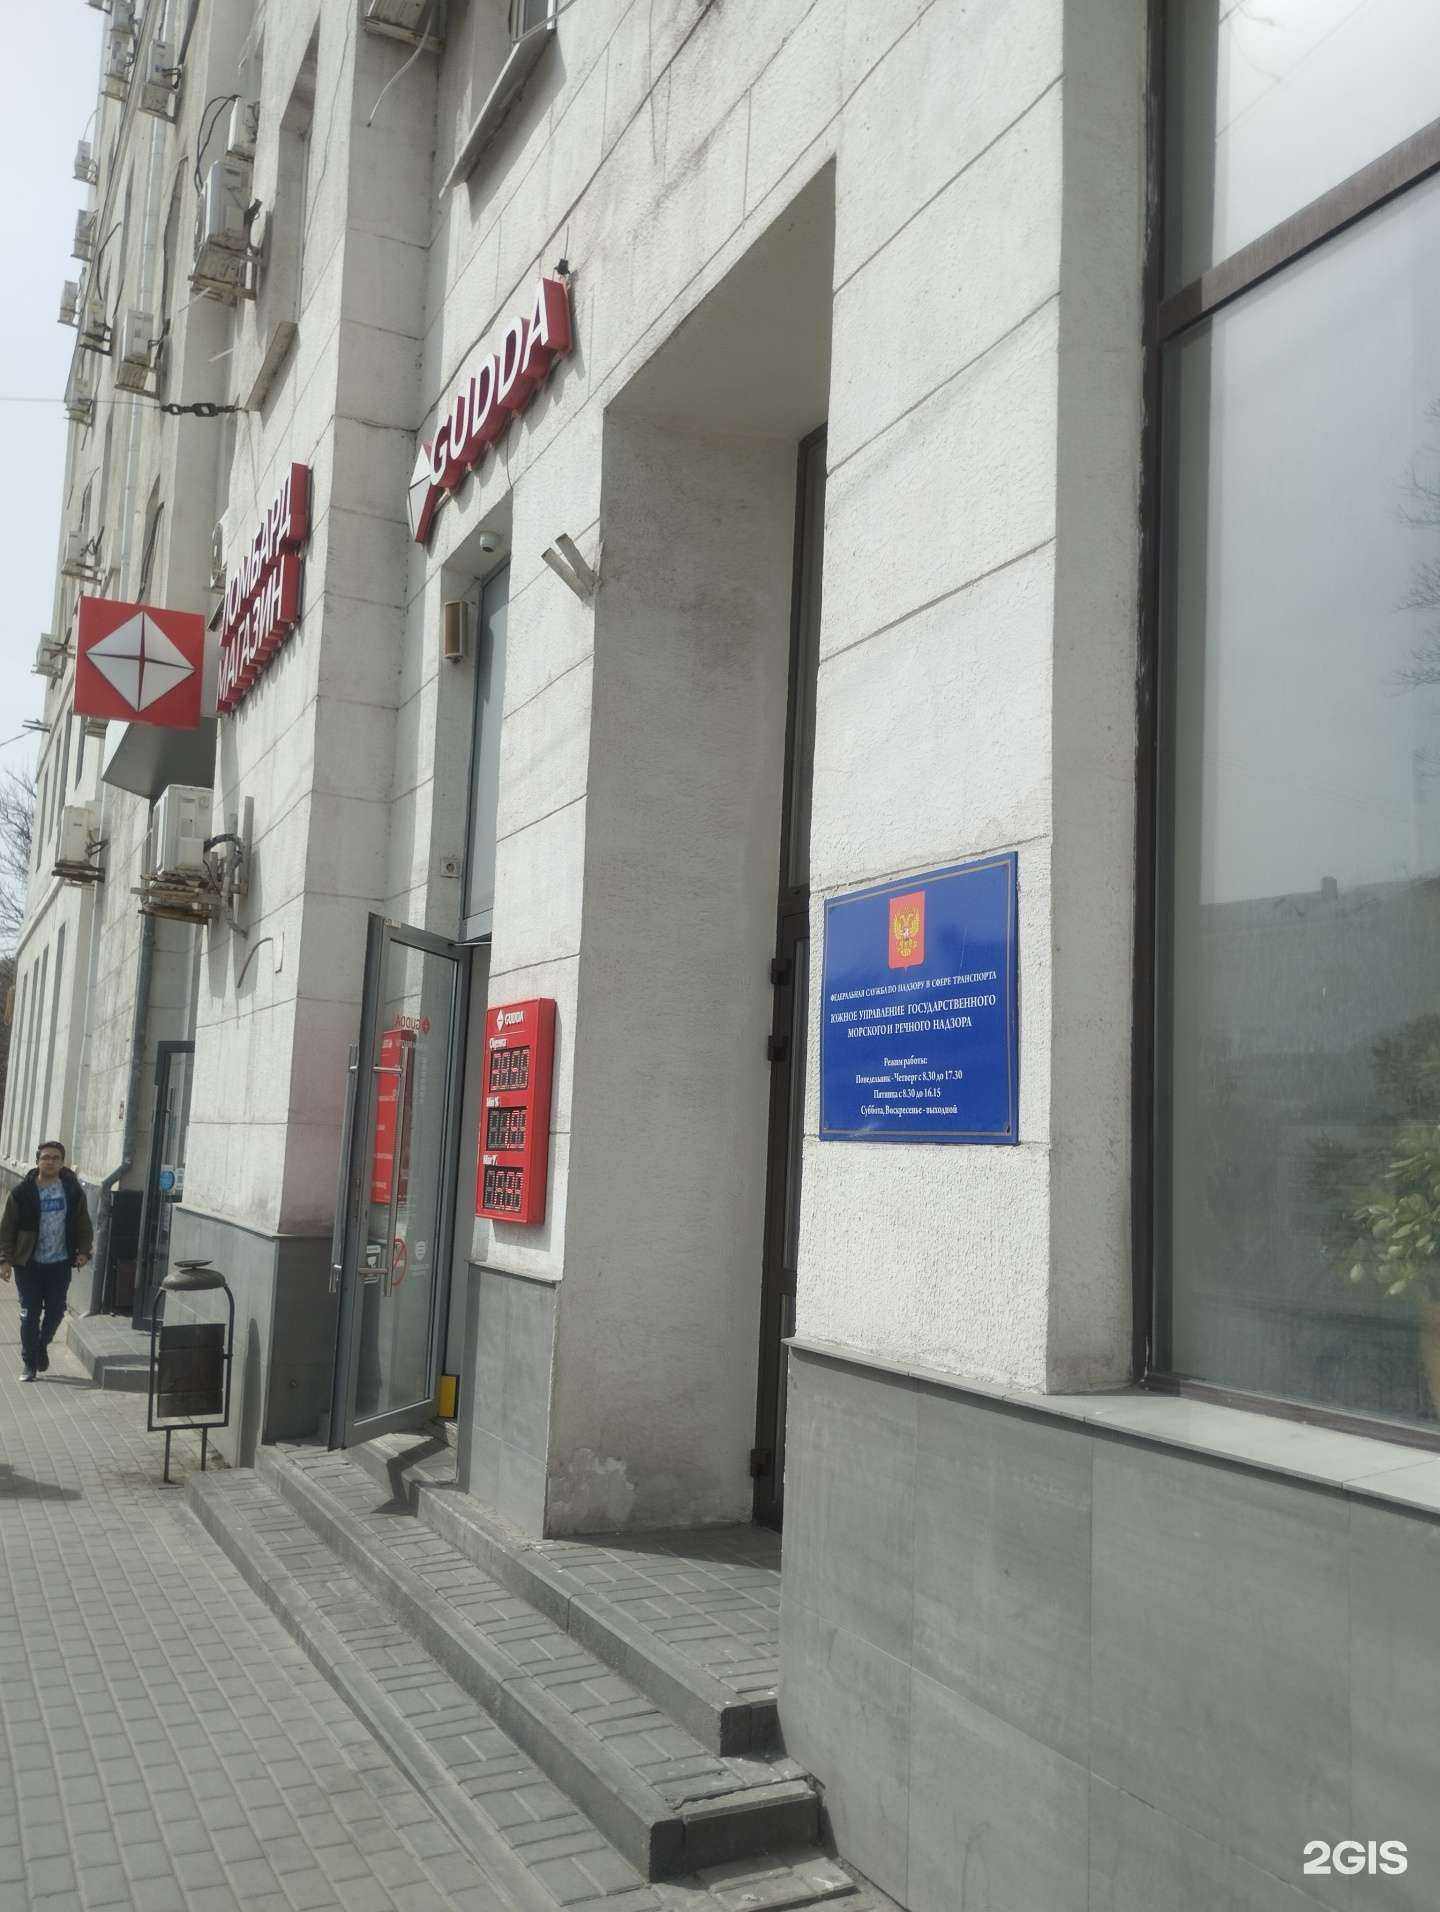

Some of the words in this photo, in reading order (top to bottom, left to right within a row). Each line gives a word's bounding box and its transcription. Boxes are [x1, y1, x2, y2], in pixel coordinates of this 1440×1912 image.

[431, 277, 549, 487] GUDDA
[216, 554, 285, 711] МАГАЗИН
[931, 976, 952, 988] СФЕРЕ
[953, 970, 997, 985] ТРАНСПОРТА
[830, 1010, 858, 1024] ЮЖНОЕ
[859, 1004, 905, 1021] УПРАВЛЕНИЕ
[907, 994, 996, 1015] ГОСУДАРСТВЕННОГО
[847, 1024, 887, 1038] МОРСКОГО
[887, 1024, 893, 1035] И
[895, 1019, 931, 1034] РЕЧНОГО
[933, 1016, 972, 1030] НАДЗОРА
[903, 1055, 928, 1068] работы:
[894, 1072, 918, 1085] Четверг
[922, 1071, 936, 1081] 8.30
[945, 1070, 963, 1080] 17.30
[902, 1089, 915, 1098] 8.30
[915, 1092, 924, 1100] до
[924, 1088, 941, 1098] 16.15
[885, 1105, 922, 1118] Воскресенье
[926, 1105, 958, 1115] выходной
